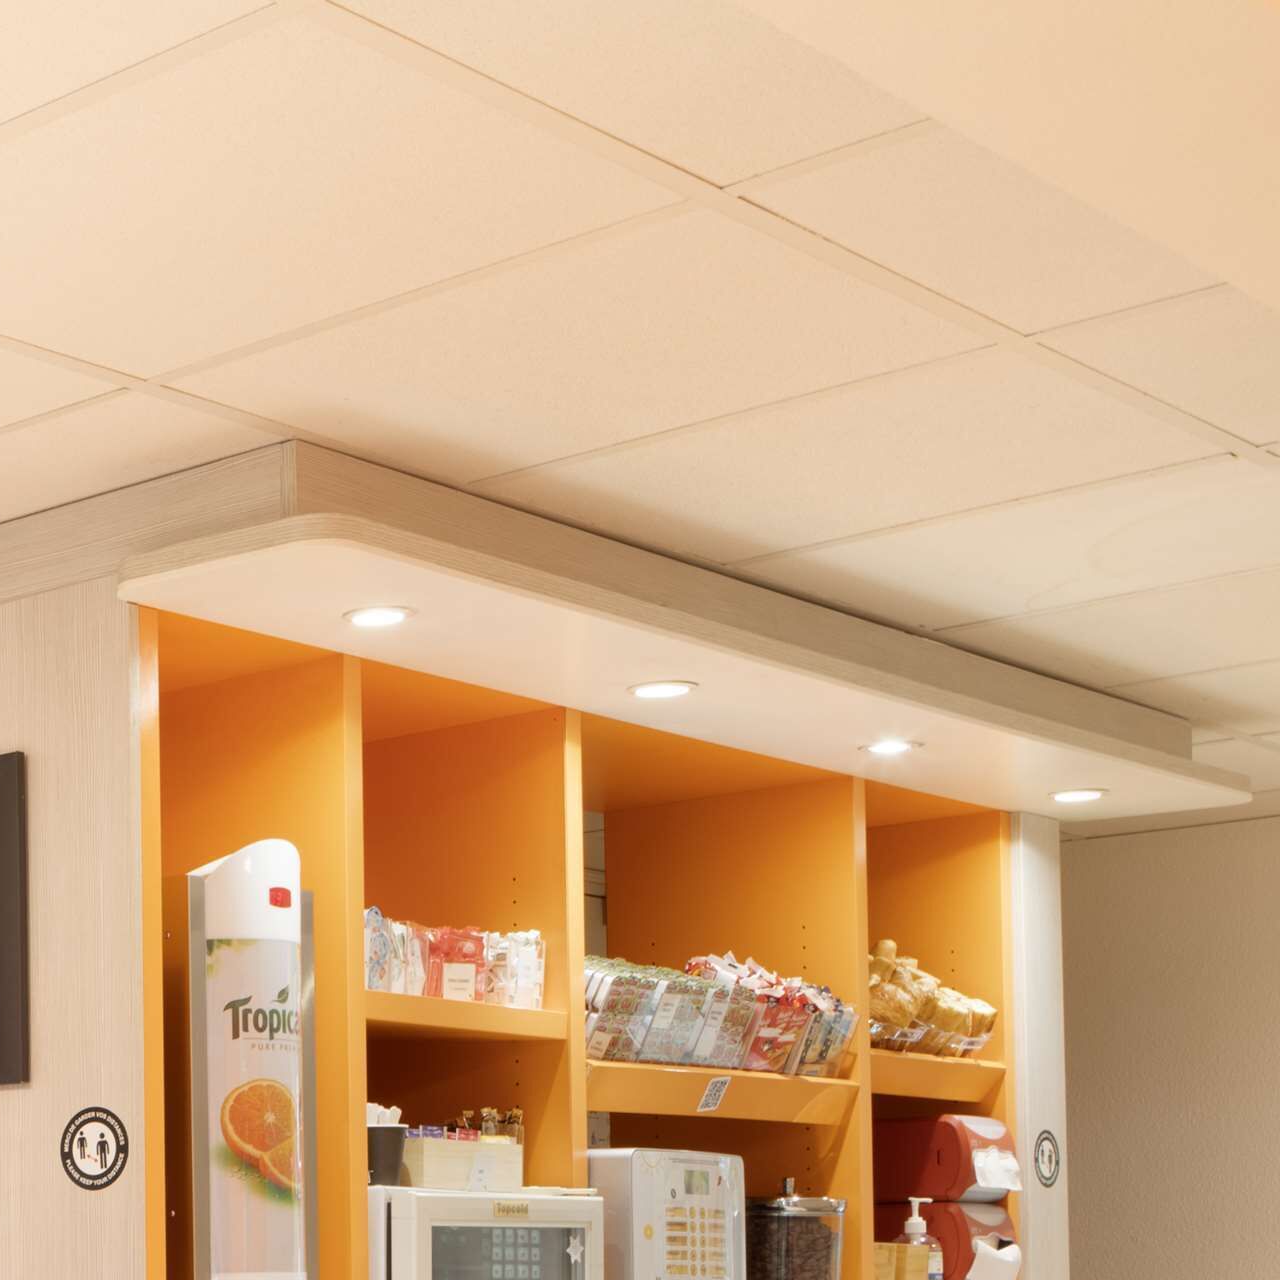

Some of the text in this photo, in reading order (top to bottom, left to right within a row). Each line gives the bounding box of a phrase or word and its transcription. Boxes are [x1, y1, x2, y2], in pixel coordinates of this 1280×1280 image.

[63, 1111, 125, 1153] MERCI DE GARDER VOS DISTANCES
[66, 1153, 125, 1186] PLEASE KEEP YOUR DISTANCE
